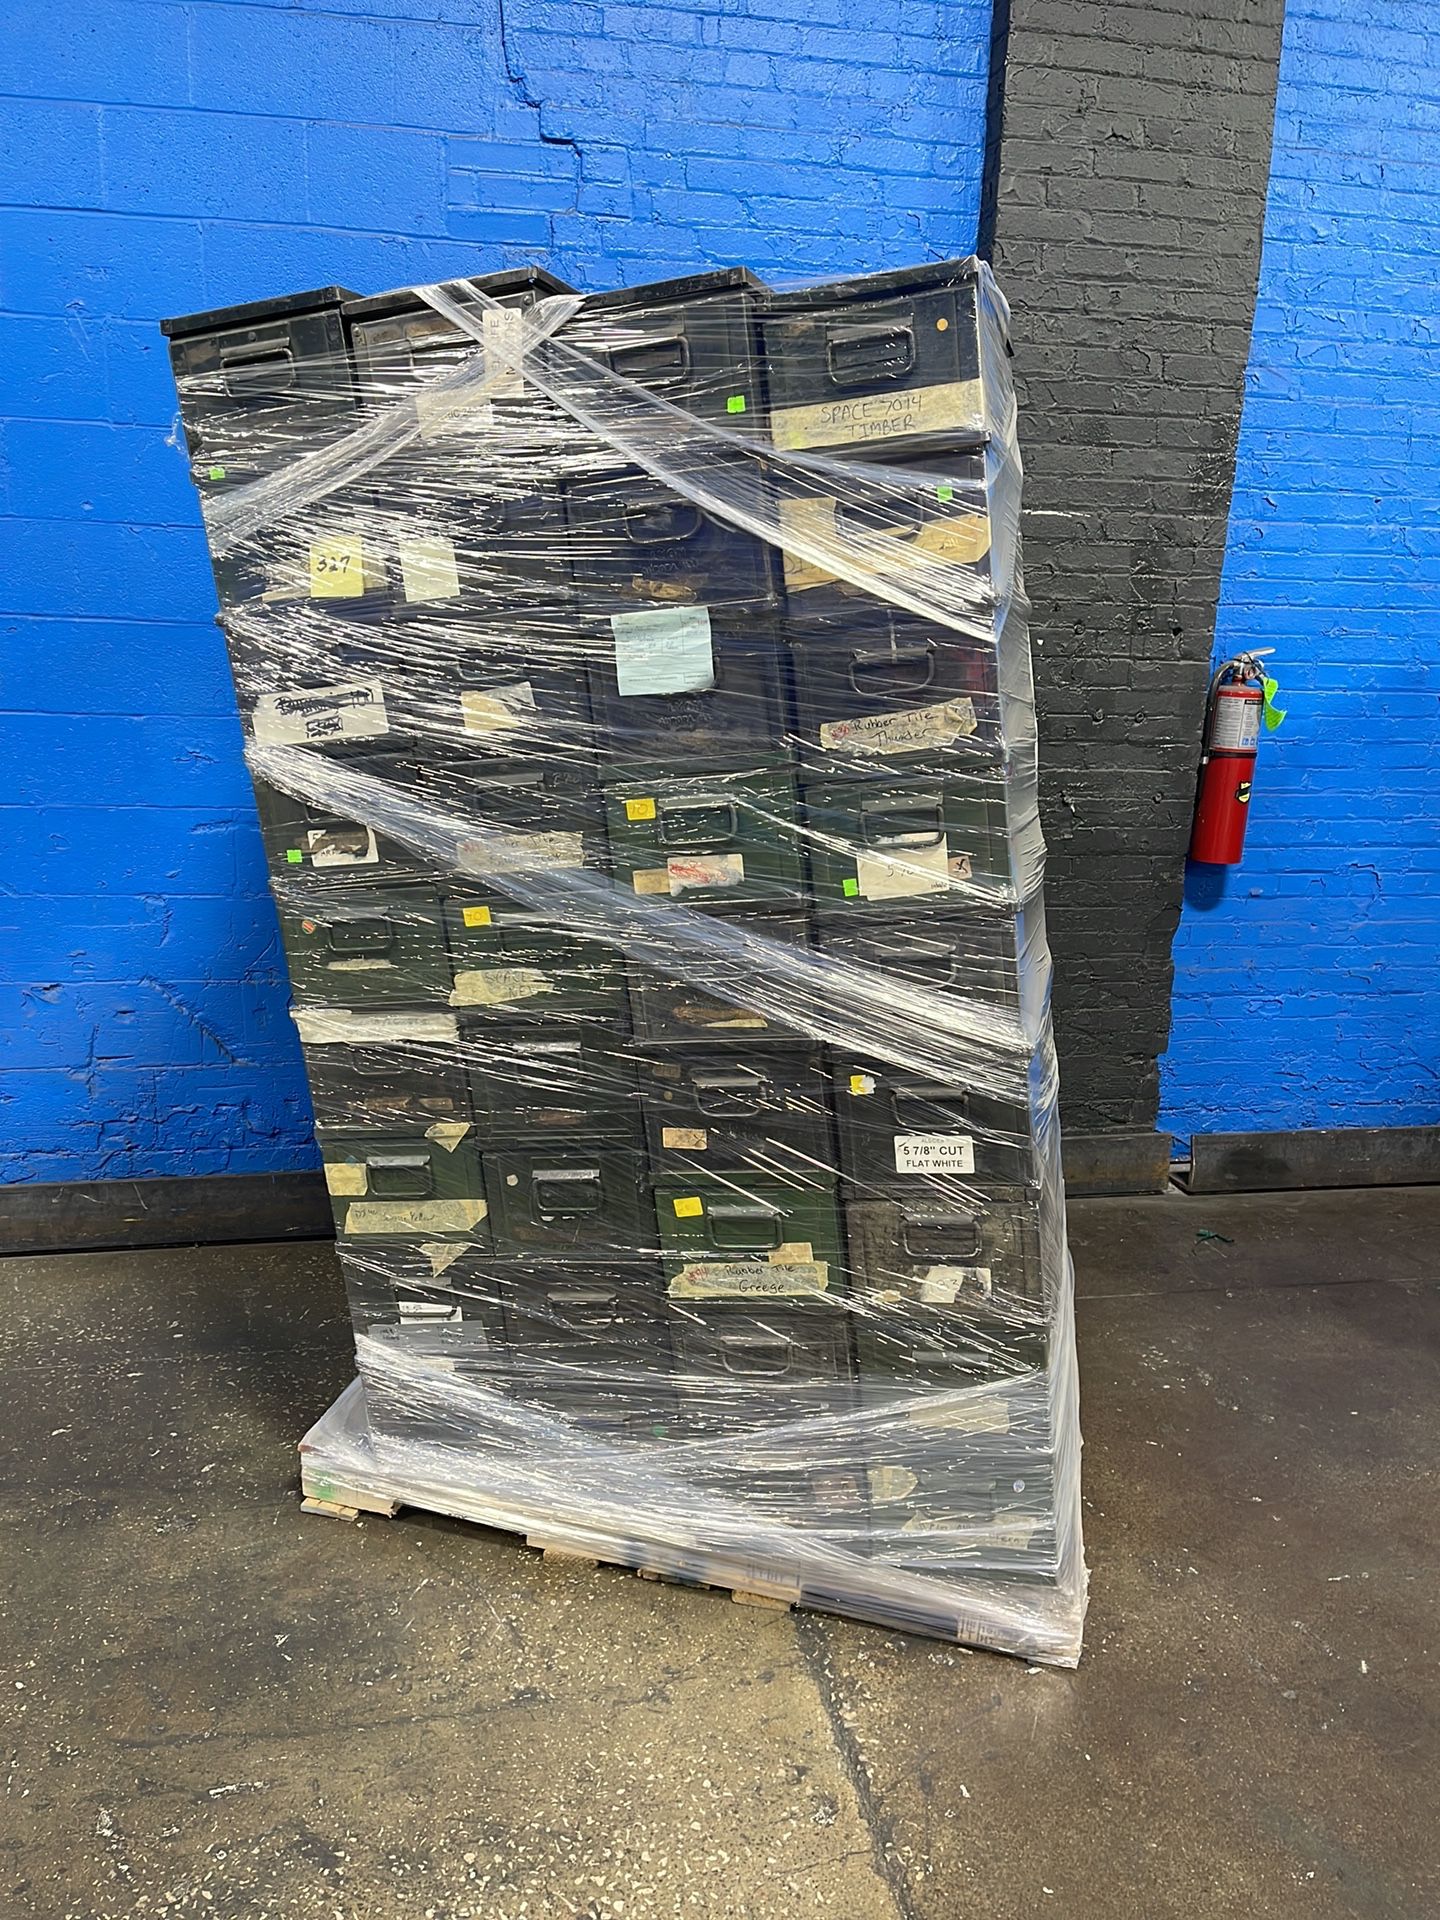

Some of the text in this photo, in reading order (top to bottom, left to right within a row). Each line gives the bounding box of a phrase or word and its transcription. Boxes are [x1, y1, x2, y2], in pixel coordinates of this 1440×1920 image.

[820, 395, 922, 424] SPACE 7014
[845, 414, 916, 439] TIMBER
[316, 555, 351, 574] 327
[852, 711, 937, 731] Rubber Tile
[868, 727, 939, 747] Thunder
[903, 1145, 964, 1156] 5 7/8" CUT
[906, 1159, 963, 1168] FLAT WHITE
